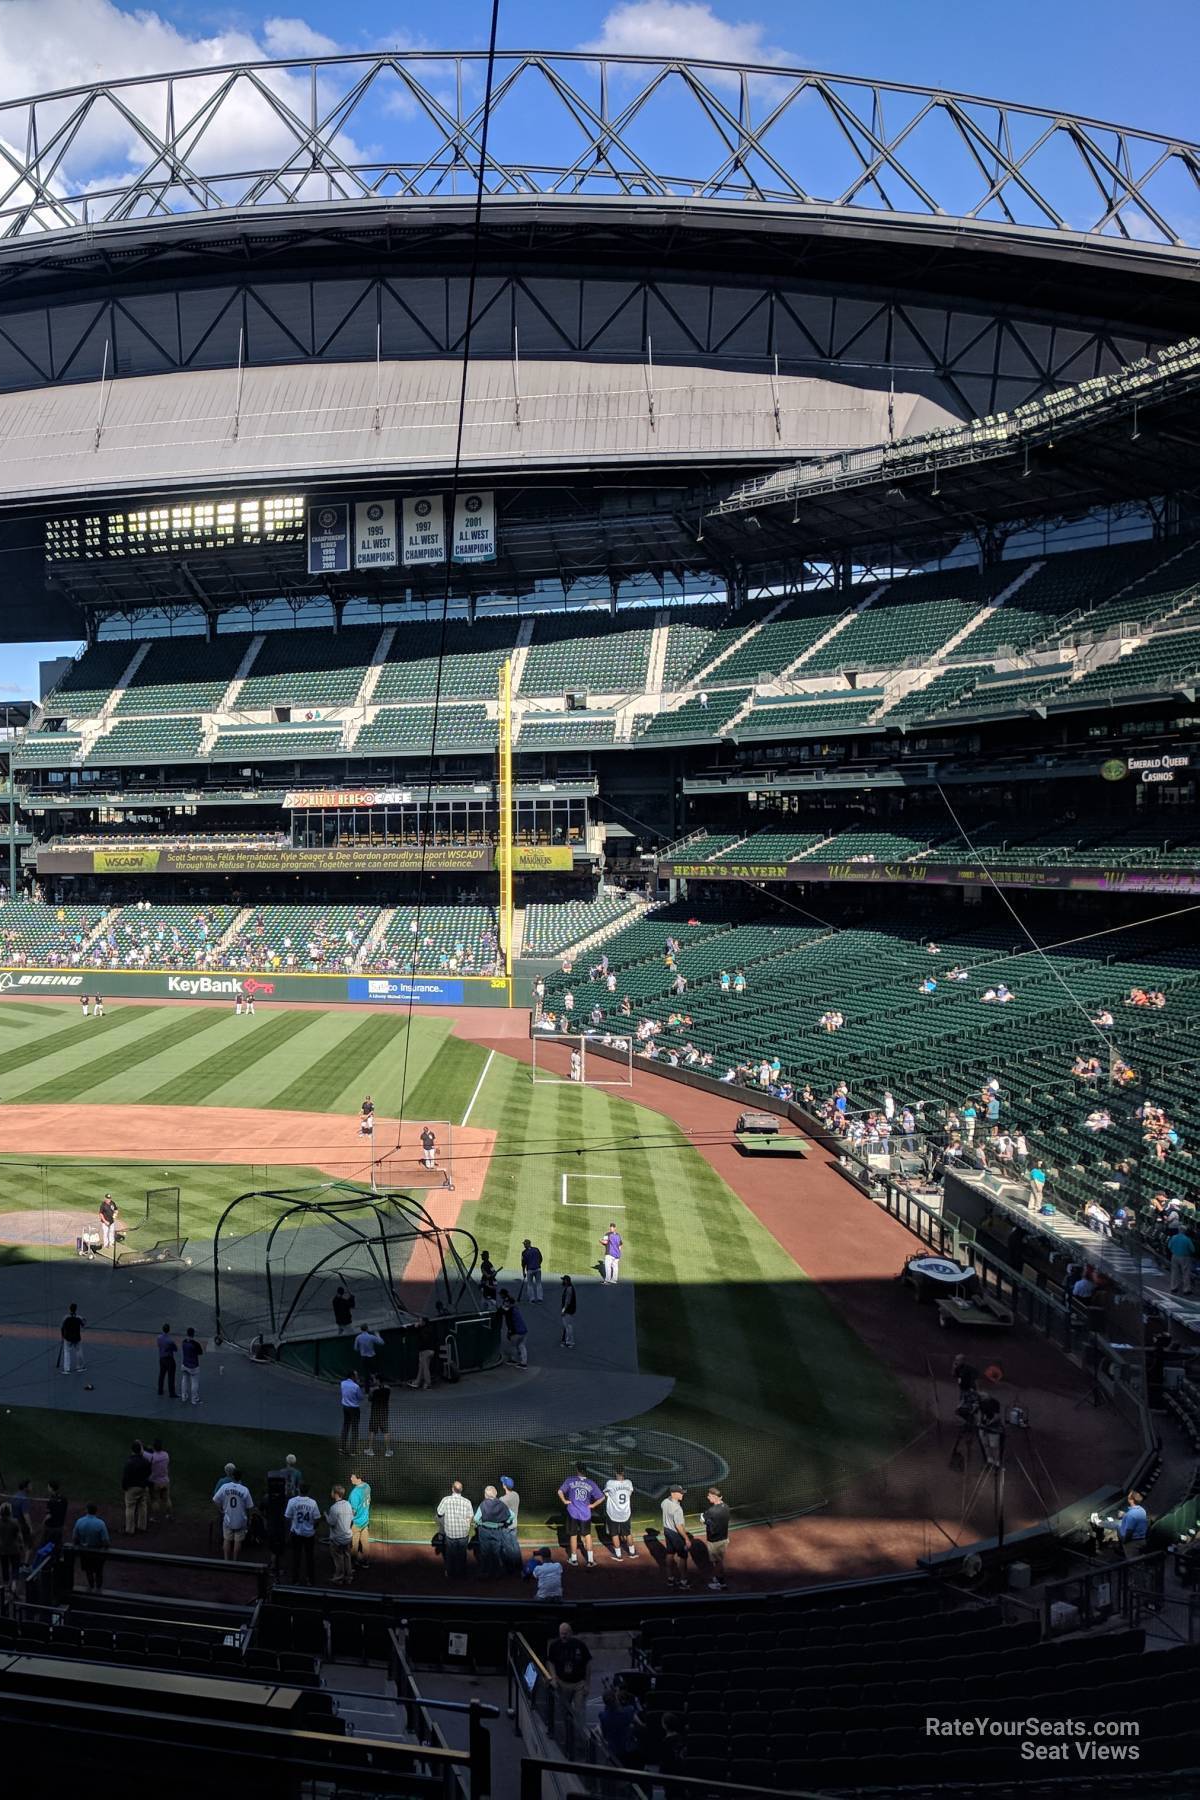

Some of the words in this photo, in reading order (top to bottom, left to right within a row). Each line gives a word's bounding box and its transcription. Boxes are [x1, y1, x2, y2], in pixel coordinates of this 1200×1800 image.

[416, 521, 431, 531] 1997
[465, 517, 482, 527] 2001
[367, 526, 384, 535] 1995
[459, 531, 470, 541] A.L.
[471, 529, 489, 540] WEST
[361, 540, 373, 550] A.L.
[373, 538, 391, 549] WEST
[409, 536, 420, 546] A.L.
[421, 534, 439, 545] WEST
[405, 547, 443, 560] CHAMPIONS
[455, 543, 493, 555] CHAMPIONS
[357, 551, 395, 563] CHAMPIONS
[104, 857, 144, 867] WSCADV
[167, 853, 185, 861] Scott
[187, 853, 215, 862] Servais,
[280, 852, 297, 862] Kyle
[299, 852, 326, 862] Seager
[327, 852, 333, 860] &
[336, 851, 350, 860] Dee
[352, 851, 381, 860] Gordon
[383, 851, 413, 861] proudly
[414, 851, 446, 861] support
[447, 850, 485, 859] WSCADV
[176, 861, 203, 870] through
[205, 861, 218, 869] the
[219, 861, 244, 869] Refuse
[246, 861, 255, 869] To
[256, 861, 280, 869] Abuse
[281, 861, 316, 870] program.
[319, 860, 353, 869] Together
[383, 860, 398, 868] end
[400, 860, 436, 868] domestic
[438, 860, 473, 868] violence.
[673, 865, 728, 877] HENRY'S
[732, 866, 788, 878] TAVERN
[18, 975, 83, 986] BOEING
[168, 976, 243, 993] KeyBank
[401, 981, 442, 992] Insurance
[491, 979, 506, 988] 326
[230, 1496, 237, 1508] 0
[618, 1493, 626, 1504] 9
[297, 1511, 310, 1523] 24
